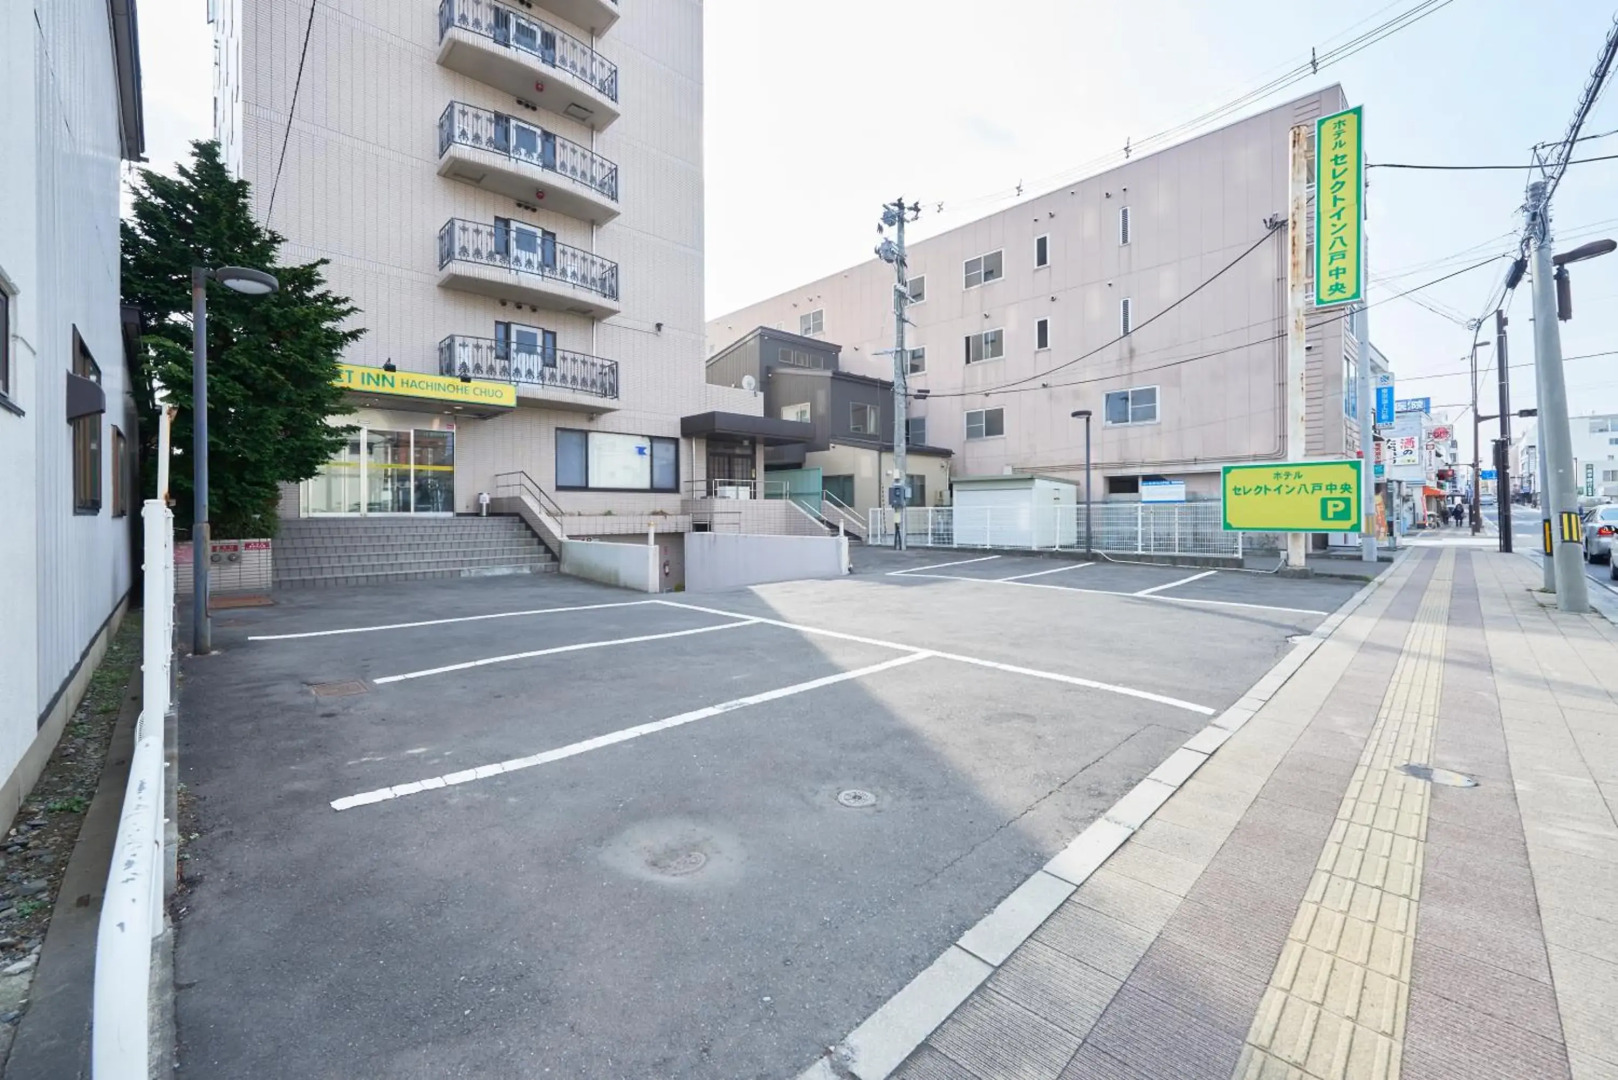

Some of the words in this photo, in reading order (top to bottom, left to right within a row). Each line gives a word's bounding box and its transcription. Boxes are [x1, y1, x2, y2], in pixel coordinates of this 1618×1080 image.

[1332, 119, 1347, 149] ホテル
[1328, 153, 1348, 296] セレクトイン八戸中央
[361, 371, 395, 389] INN
[401, 379, 470, 396] HACHINOHE
[473, 386, 504, 400] CHUO
[1273, 470, 1303, 480] ホテル
[1232, 482, 1353, 497] セレクトイン八戸中央
[1327, 500, 1345, 519] P
